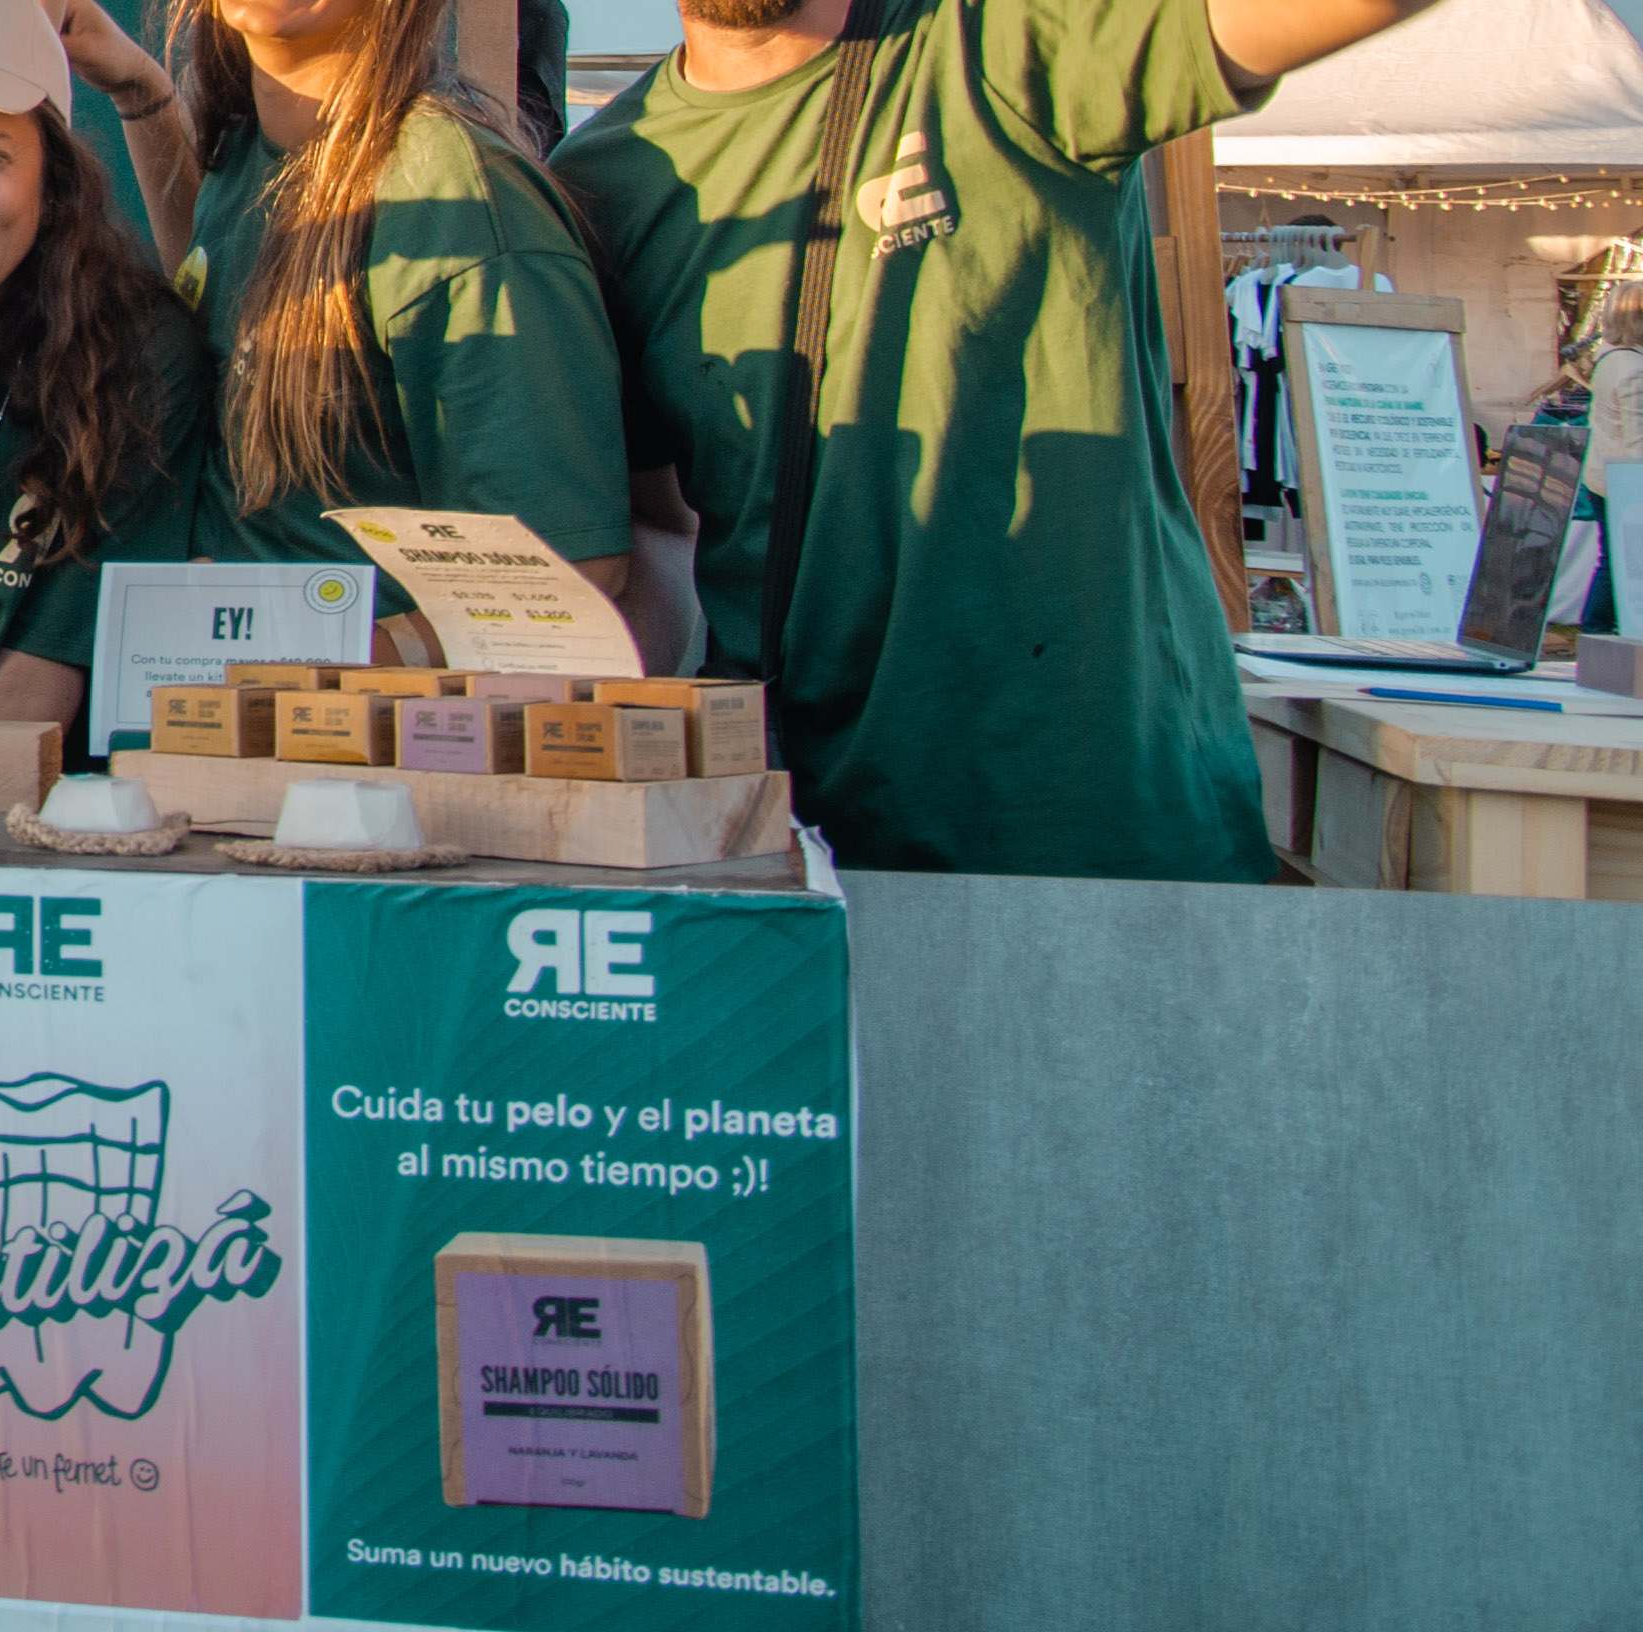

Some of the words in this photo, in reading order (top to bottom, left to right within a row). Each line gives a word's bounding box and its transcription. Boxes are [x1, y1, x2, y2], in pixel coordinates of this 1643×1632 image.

[399, 548, 485, 565] SHAMPOO
[483, 551, 550, 567] SÓLIDO
[212, 607, 253, 640] EY!
[131, 654, 156, 665] Con
[159, 654, 172, 665] tu
[175, 655, 223, 668] compra
[145, 671, 185, 682] llevate
[189, 672, 204, 682] un
[207, 671, 223, 682] kit
[503, 998, 657, 1023] CONSCIENTE
[331, 1084, 444, 1123] Cuida
[455, 1091, 494, 1125] tu
[506, 1094, 593, 1133] pelo
[604, 1105, 627, 1138] y
[638, 1099, 672, 1132] el
[684, 1100, 838, 1140] planeta
[397, 1144, 429, 1177] al
[442, 1146, 569, 1183] mismo
[580, 1151, 718, 1195] tiempo
[481, 1365, 580, 1396] SHAMPOO
[587, 1365, 659, 1401] SÓLIDO
[508, 1447, 564, 1457] NARANJA
[580, 1450, 638, 1461] LAVANDA
[21, 1455, 48, 1480] un
[53, 1453, 123, 1493] fernet
[347, 1539, 421, 1566] Suma
[430, 1551, 463, 1570] un
[471, 1554, 552, 1576] nuevo
[561, 1554, 650, 1584] hábito
[659, 1566, 837, 1598] sustentable.
